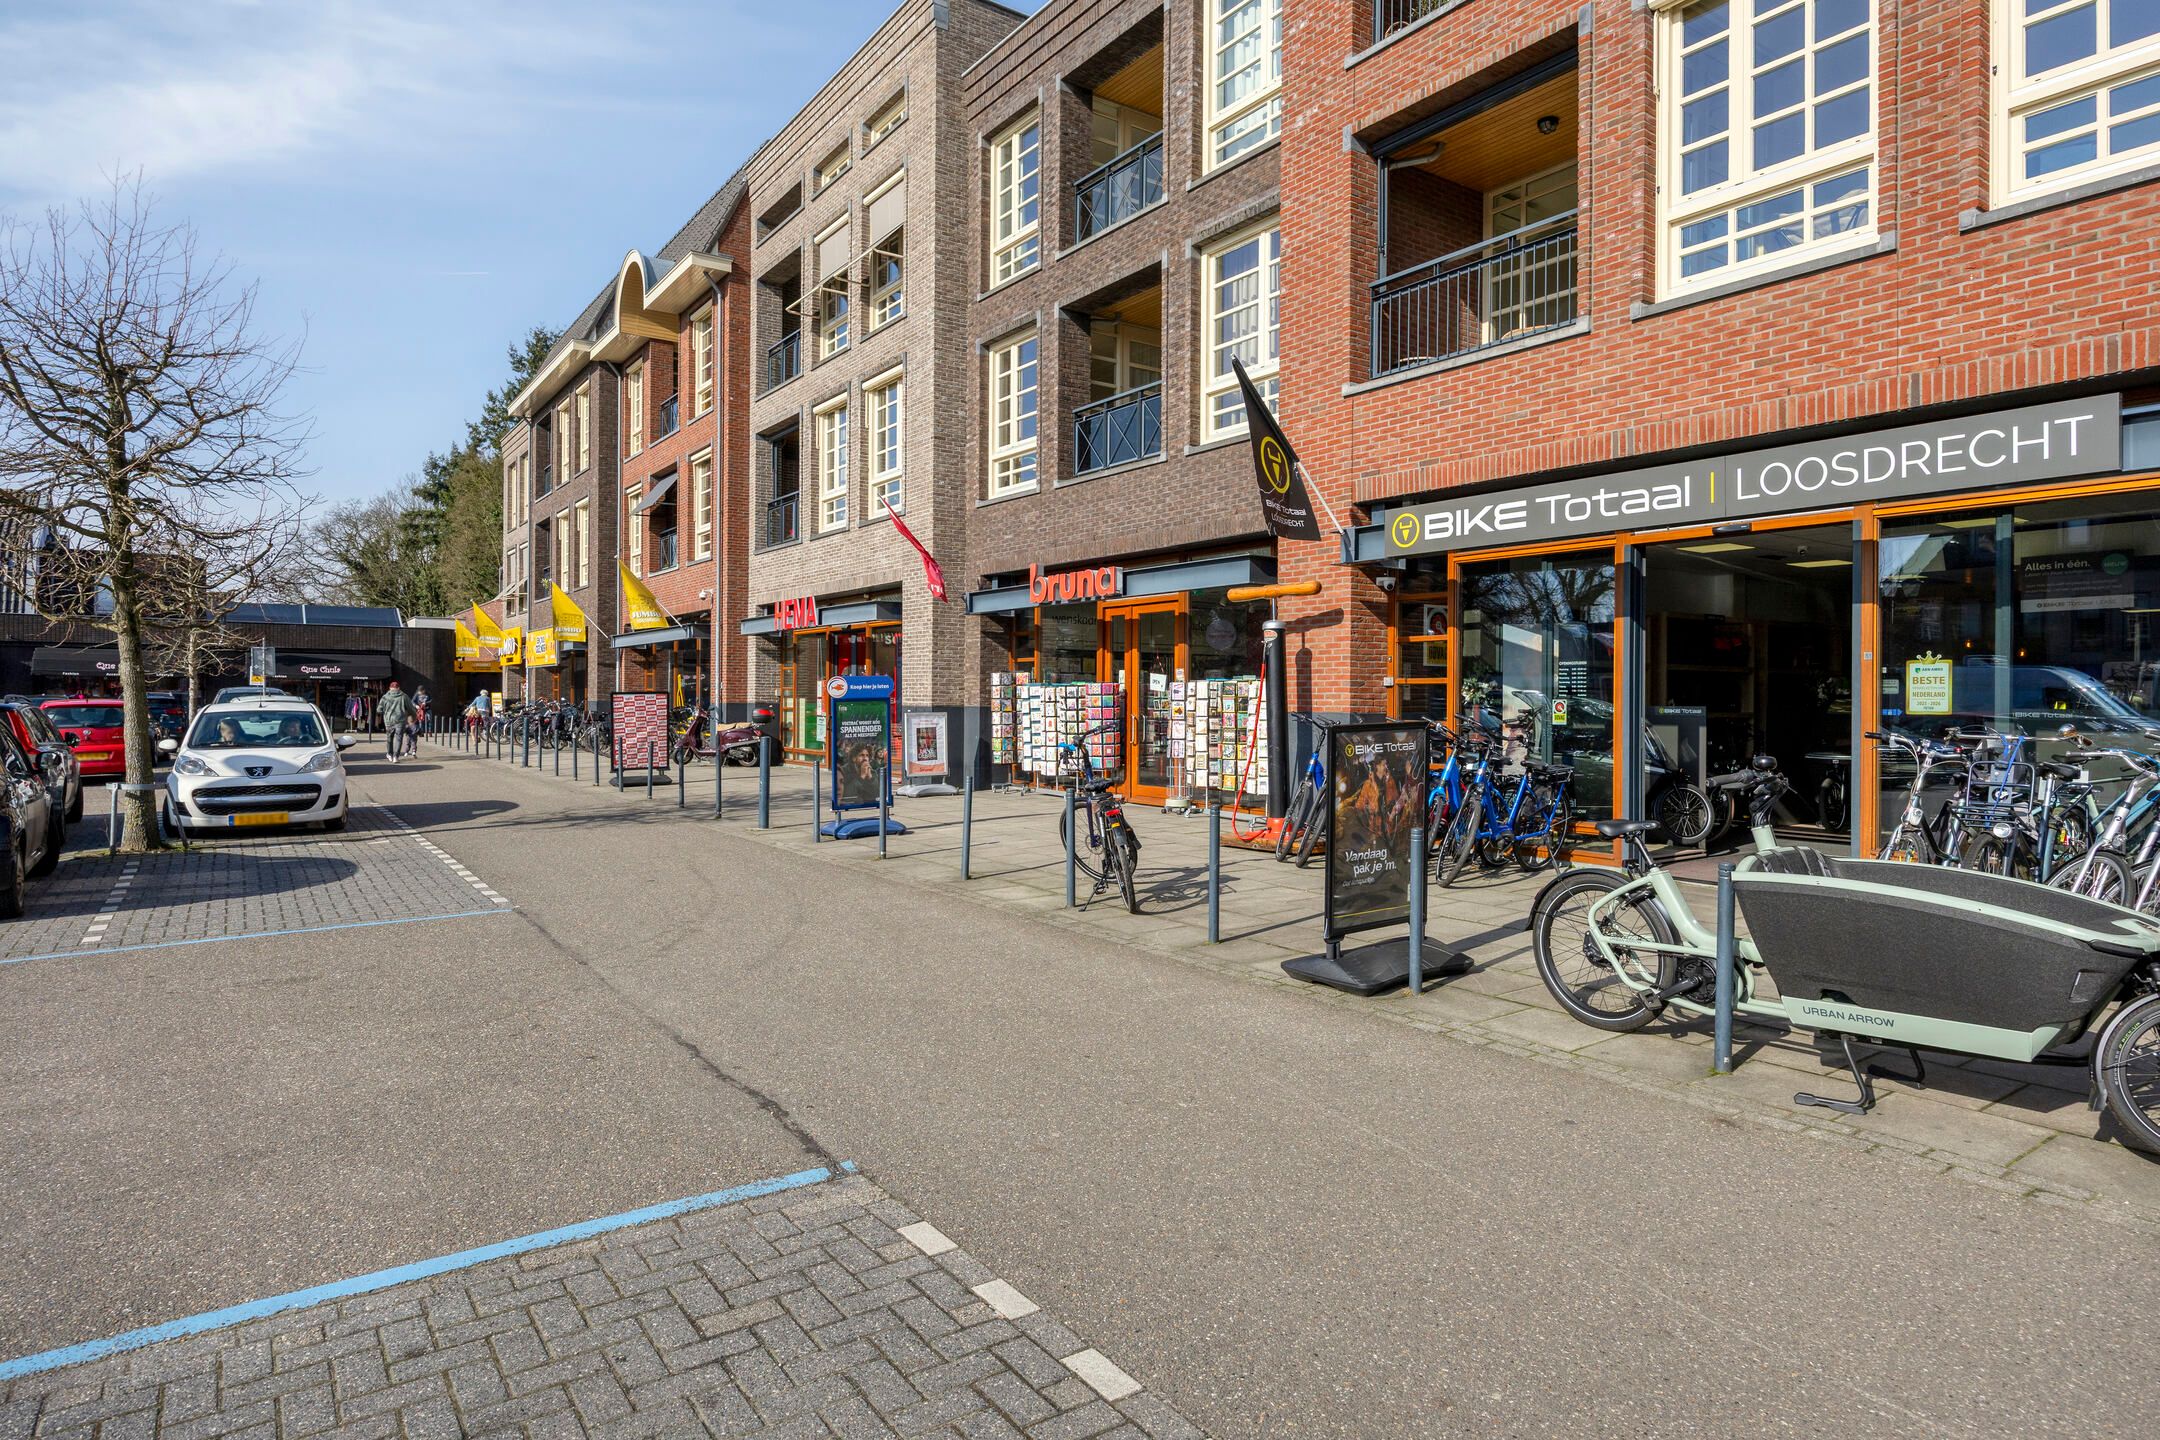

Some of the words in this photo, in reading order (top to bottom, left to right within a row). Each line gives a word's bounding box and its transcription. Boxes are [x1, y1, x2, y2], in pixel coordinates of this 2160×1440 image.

[1424, 500, 1528, 541] BIKE
[1535, 475, 1690, 525] Totaal
[1736, 414, 2094, 500] LOOSDRECHT
[2025, 562, 2052, 572] Alles
[2054, 559, 2064, 569] in
[1029, 563, 1116, 604] bruna
[774, 595, 818, 631] HEMA
[1912, 676, 1946, 685] BESTE
[840, 725, 882, 734] SPANNENDER
[1355, 743, 1384, 755] BIKE
[1384, 740, 1416, 752] Totaal
[1345, 848, 1388, 862] Vandaag
[1353, 863, 1371, 878] pak
[1371, 860, 1382, 874] je
[1802, 1005, 1845, 1020] URBAN
[1847, 1012, 1895, 1027] ARROW
